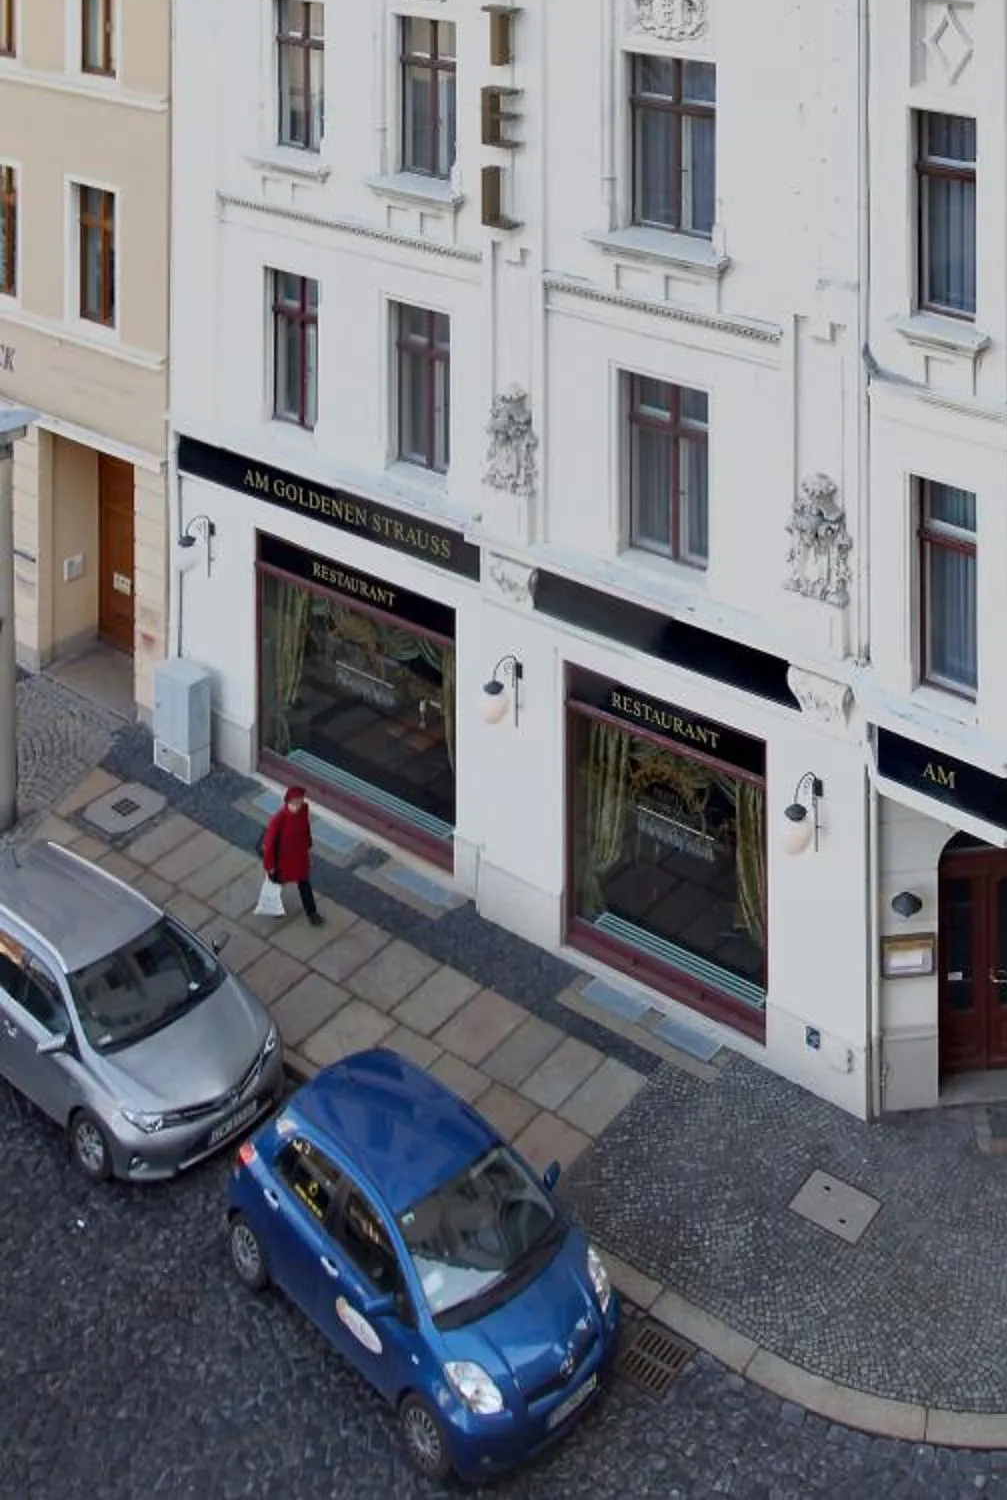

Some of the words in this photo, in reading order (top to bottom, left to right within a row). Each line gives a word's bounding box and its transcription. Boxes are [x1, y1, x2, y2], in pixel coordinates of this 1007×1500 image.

[243, 468, 269, 493] AM
[273, 480, 368, 527] GOLDENEN
[372, 513, 451, 560] STRAUSS
[312, 561, 397, 608] RESTAURANT
[611, 691, 720, 749] RESTAURANT
[921, 762, 957, 789] AM
